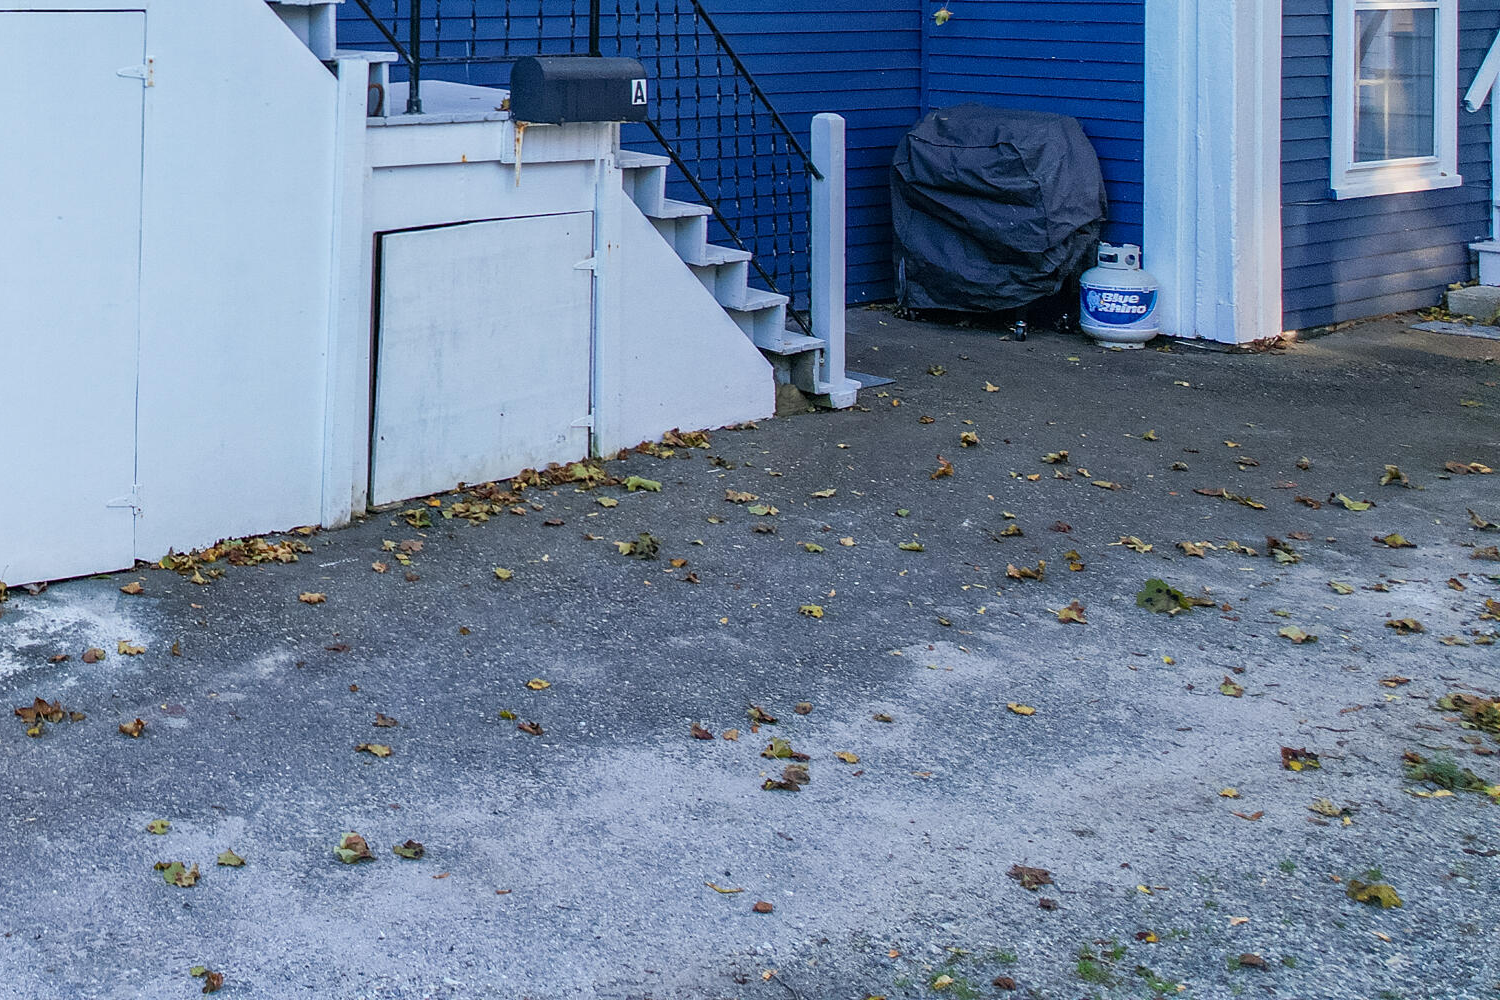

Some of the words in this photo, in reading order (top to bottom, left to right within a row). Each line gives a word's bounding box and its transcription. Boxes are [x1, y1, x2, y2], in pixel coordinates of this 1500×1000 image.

[634, 81, 645, 103] A
[1101, 292, 1140, 304] Blue
[1097, 302, 1147, 314] Rhino
